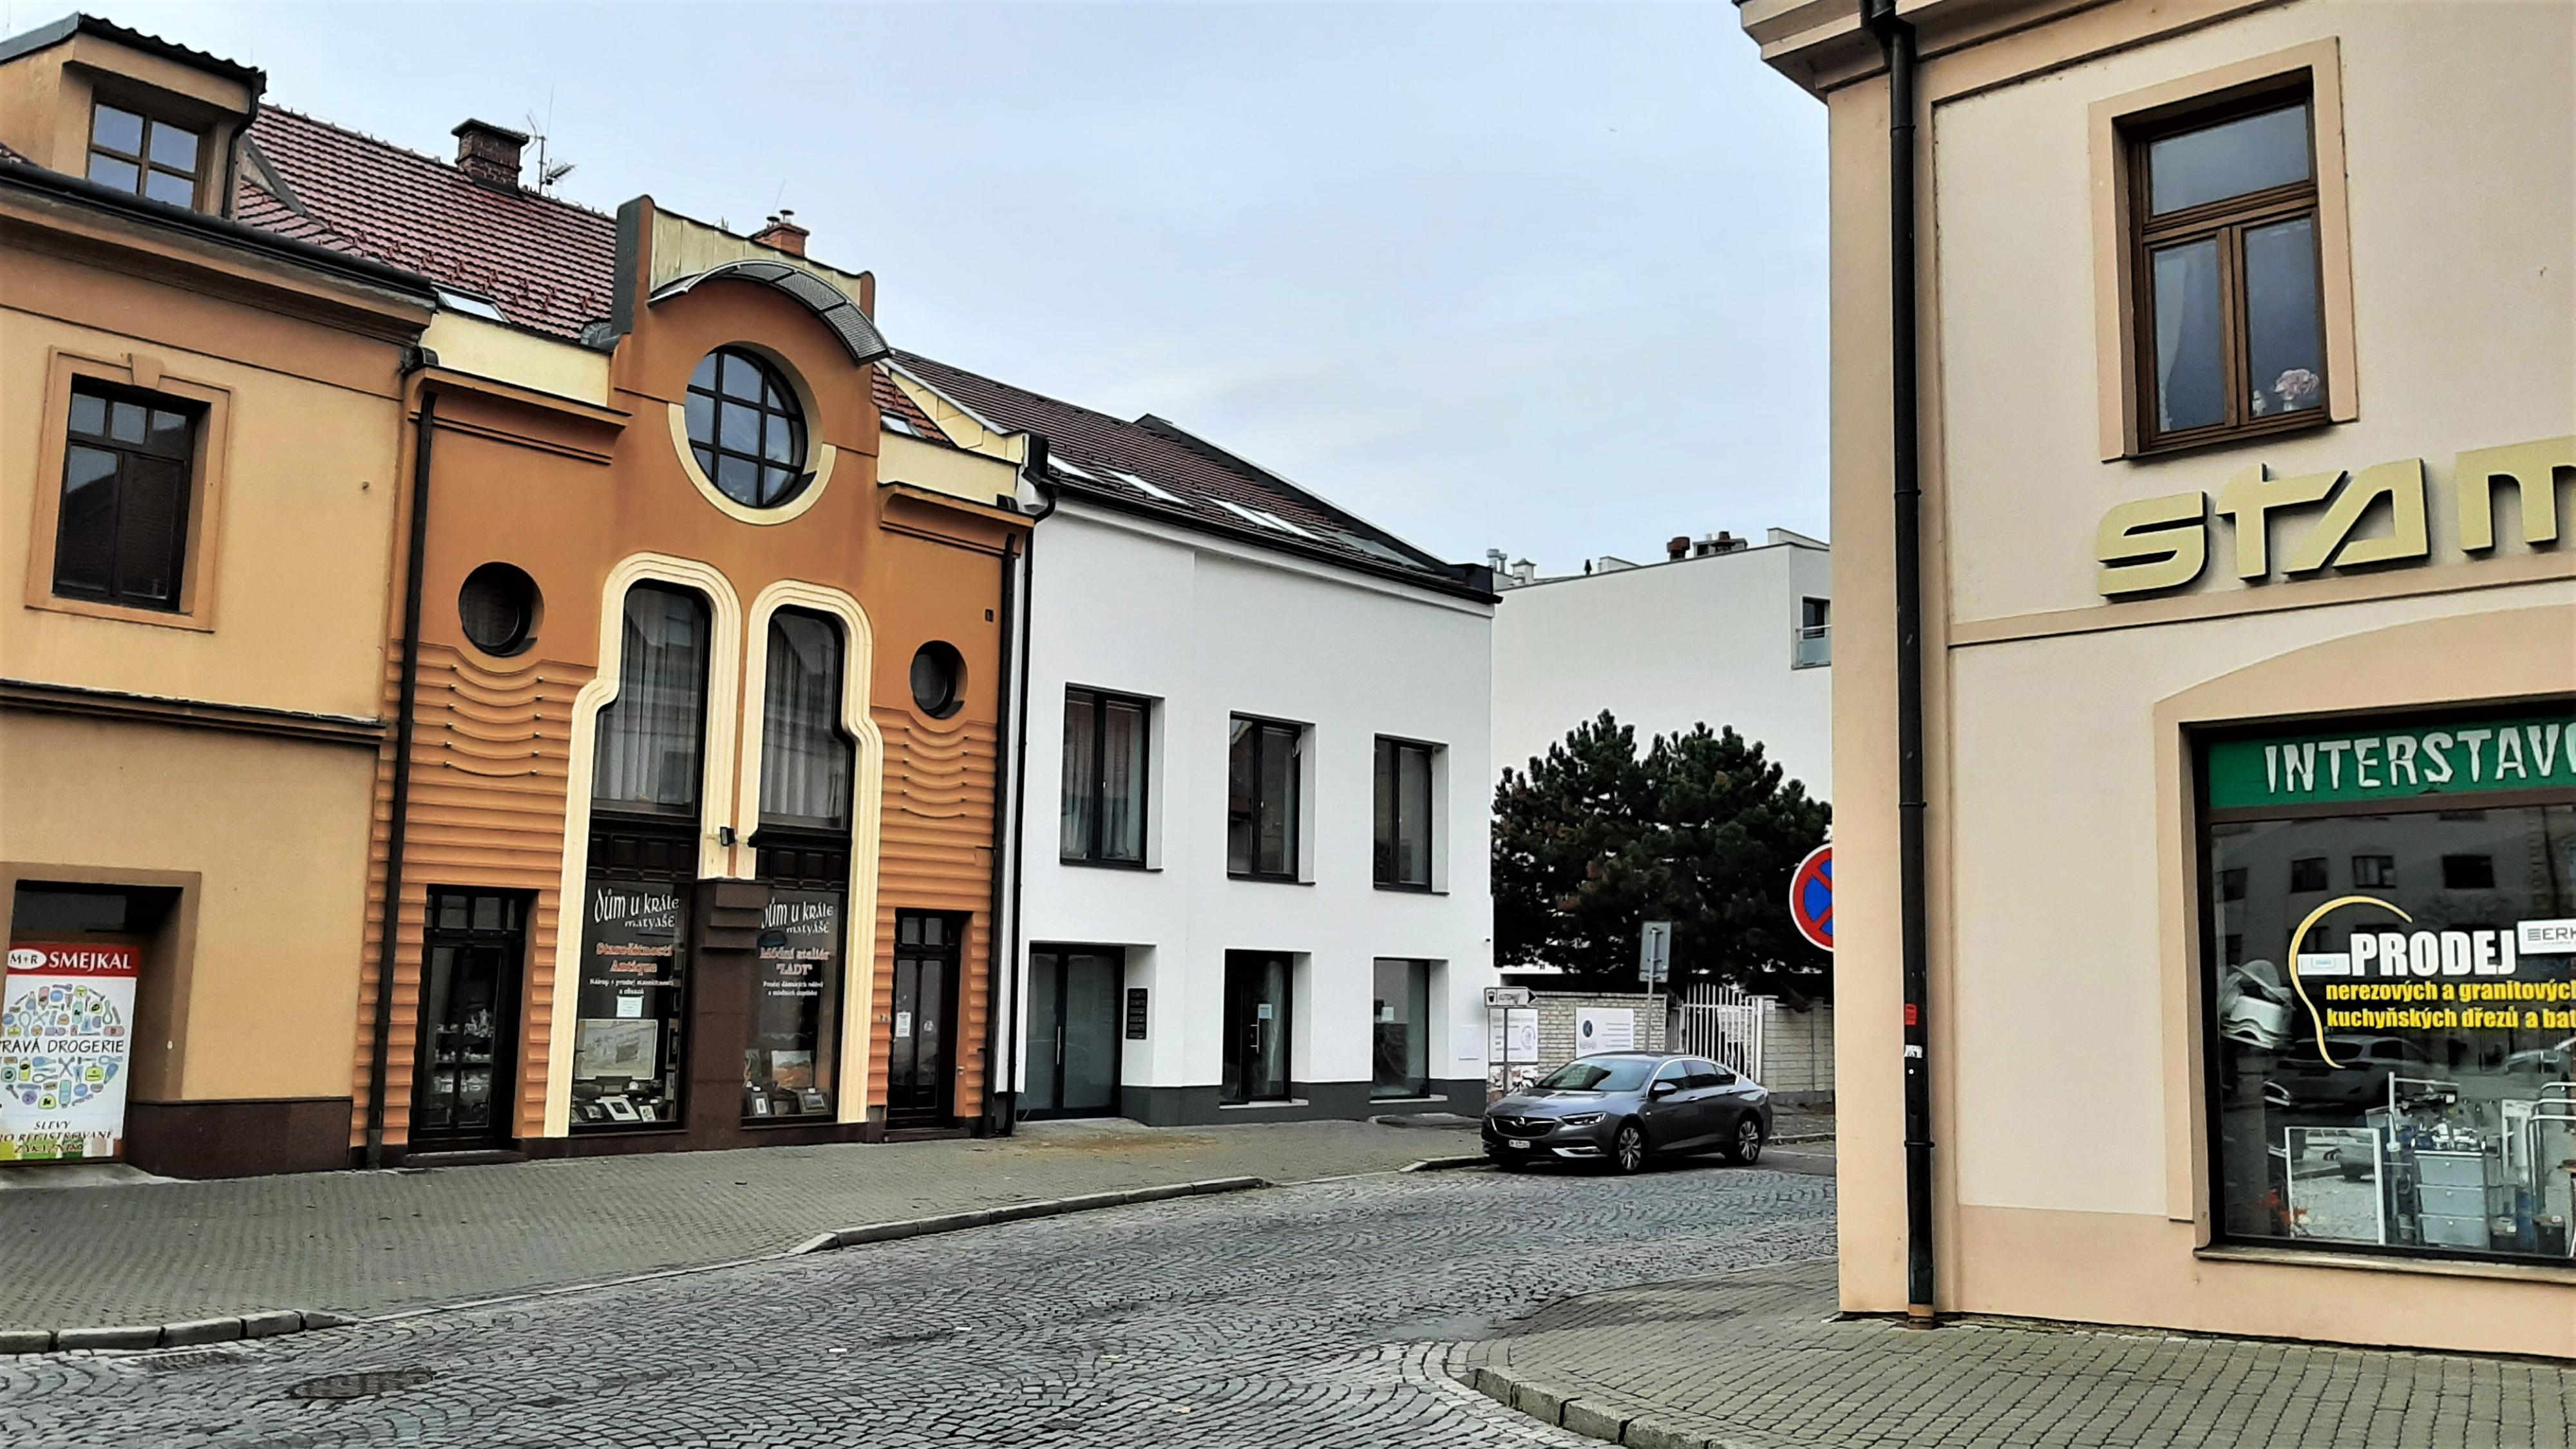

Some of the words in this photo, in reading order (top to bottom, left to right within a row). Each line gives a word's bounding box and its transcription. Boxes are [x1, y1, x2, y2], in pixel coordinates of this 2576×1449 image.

[48, 951, 131, 972] SMEJKAL
[2350, 930, 2517, 976] PRODEJ
[2326, 980, 2438, 1002] nerezových
[2441, 983, 2455, 1000] a
[2327, 1007, 2457, 1029] kuchyňských
[2461, 1005, 2519, 1028] dřezů
[2525, 1011, 2539, 1028] a
[0, 1038, 41, 1054] RAVÁ
[48, 1039, 124, 1054] DROGERIE
[34, 1121, 71, 1130] SLEVY
